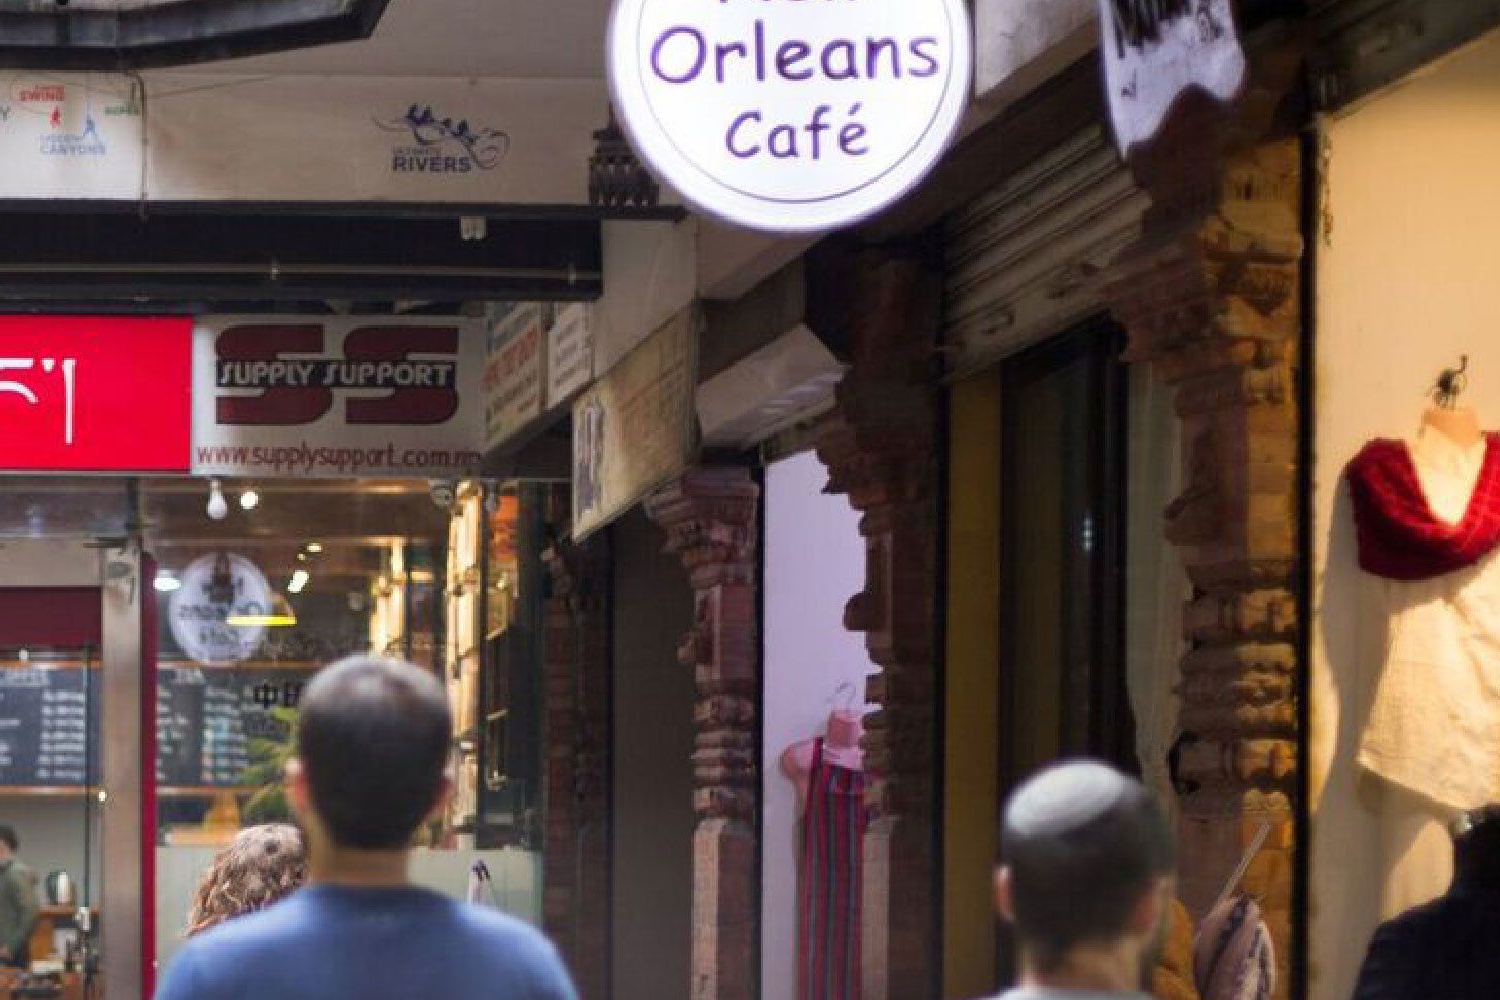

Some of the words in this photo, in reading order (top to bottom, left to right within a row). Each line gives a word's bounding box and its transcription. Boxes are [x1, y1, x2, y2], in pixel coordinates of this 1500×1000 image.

[650, 19, 939, 84] Orleans
[725, 102, 870, 160] Café
[392, 156, 471, 172] RIVERS
[220, 361, 315, 386] SUPPLY
[323, 361, 452, 386] SUPPORT
